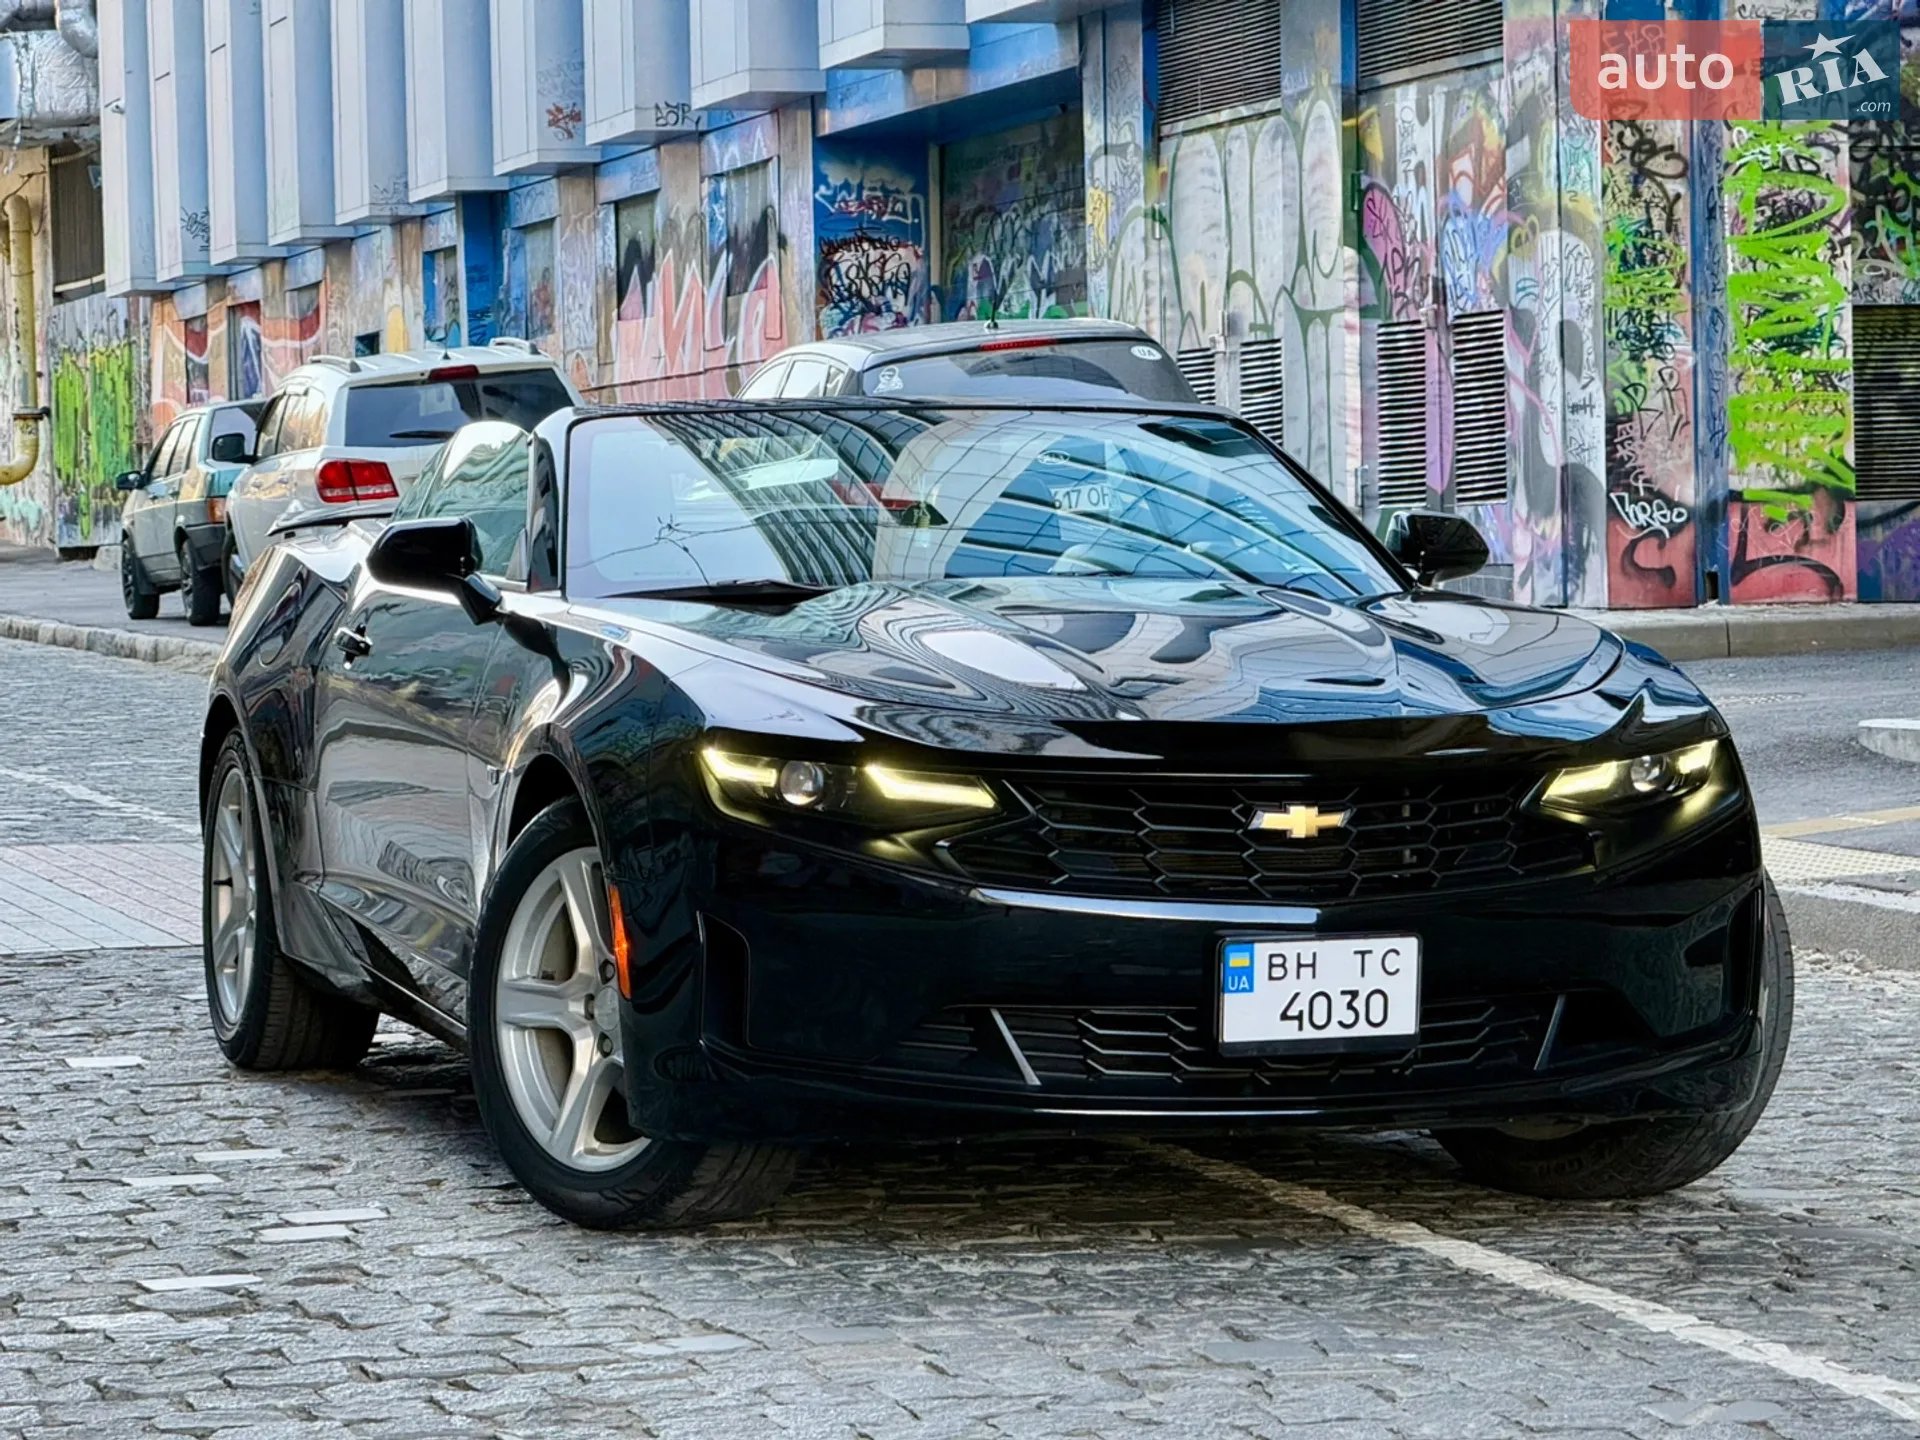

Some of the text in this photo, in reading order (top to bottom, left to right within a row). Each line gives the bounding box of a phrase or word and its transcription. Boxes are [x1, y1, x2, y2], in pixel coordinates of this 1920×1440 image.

[1267, 948, 1400, 981] BH TC
[1228, 975, 1250, 991] UA
[1279, 988, 1389, 1032] 4030
